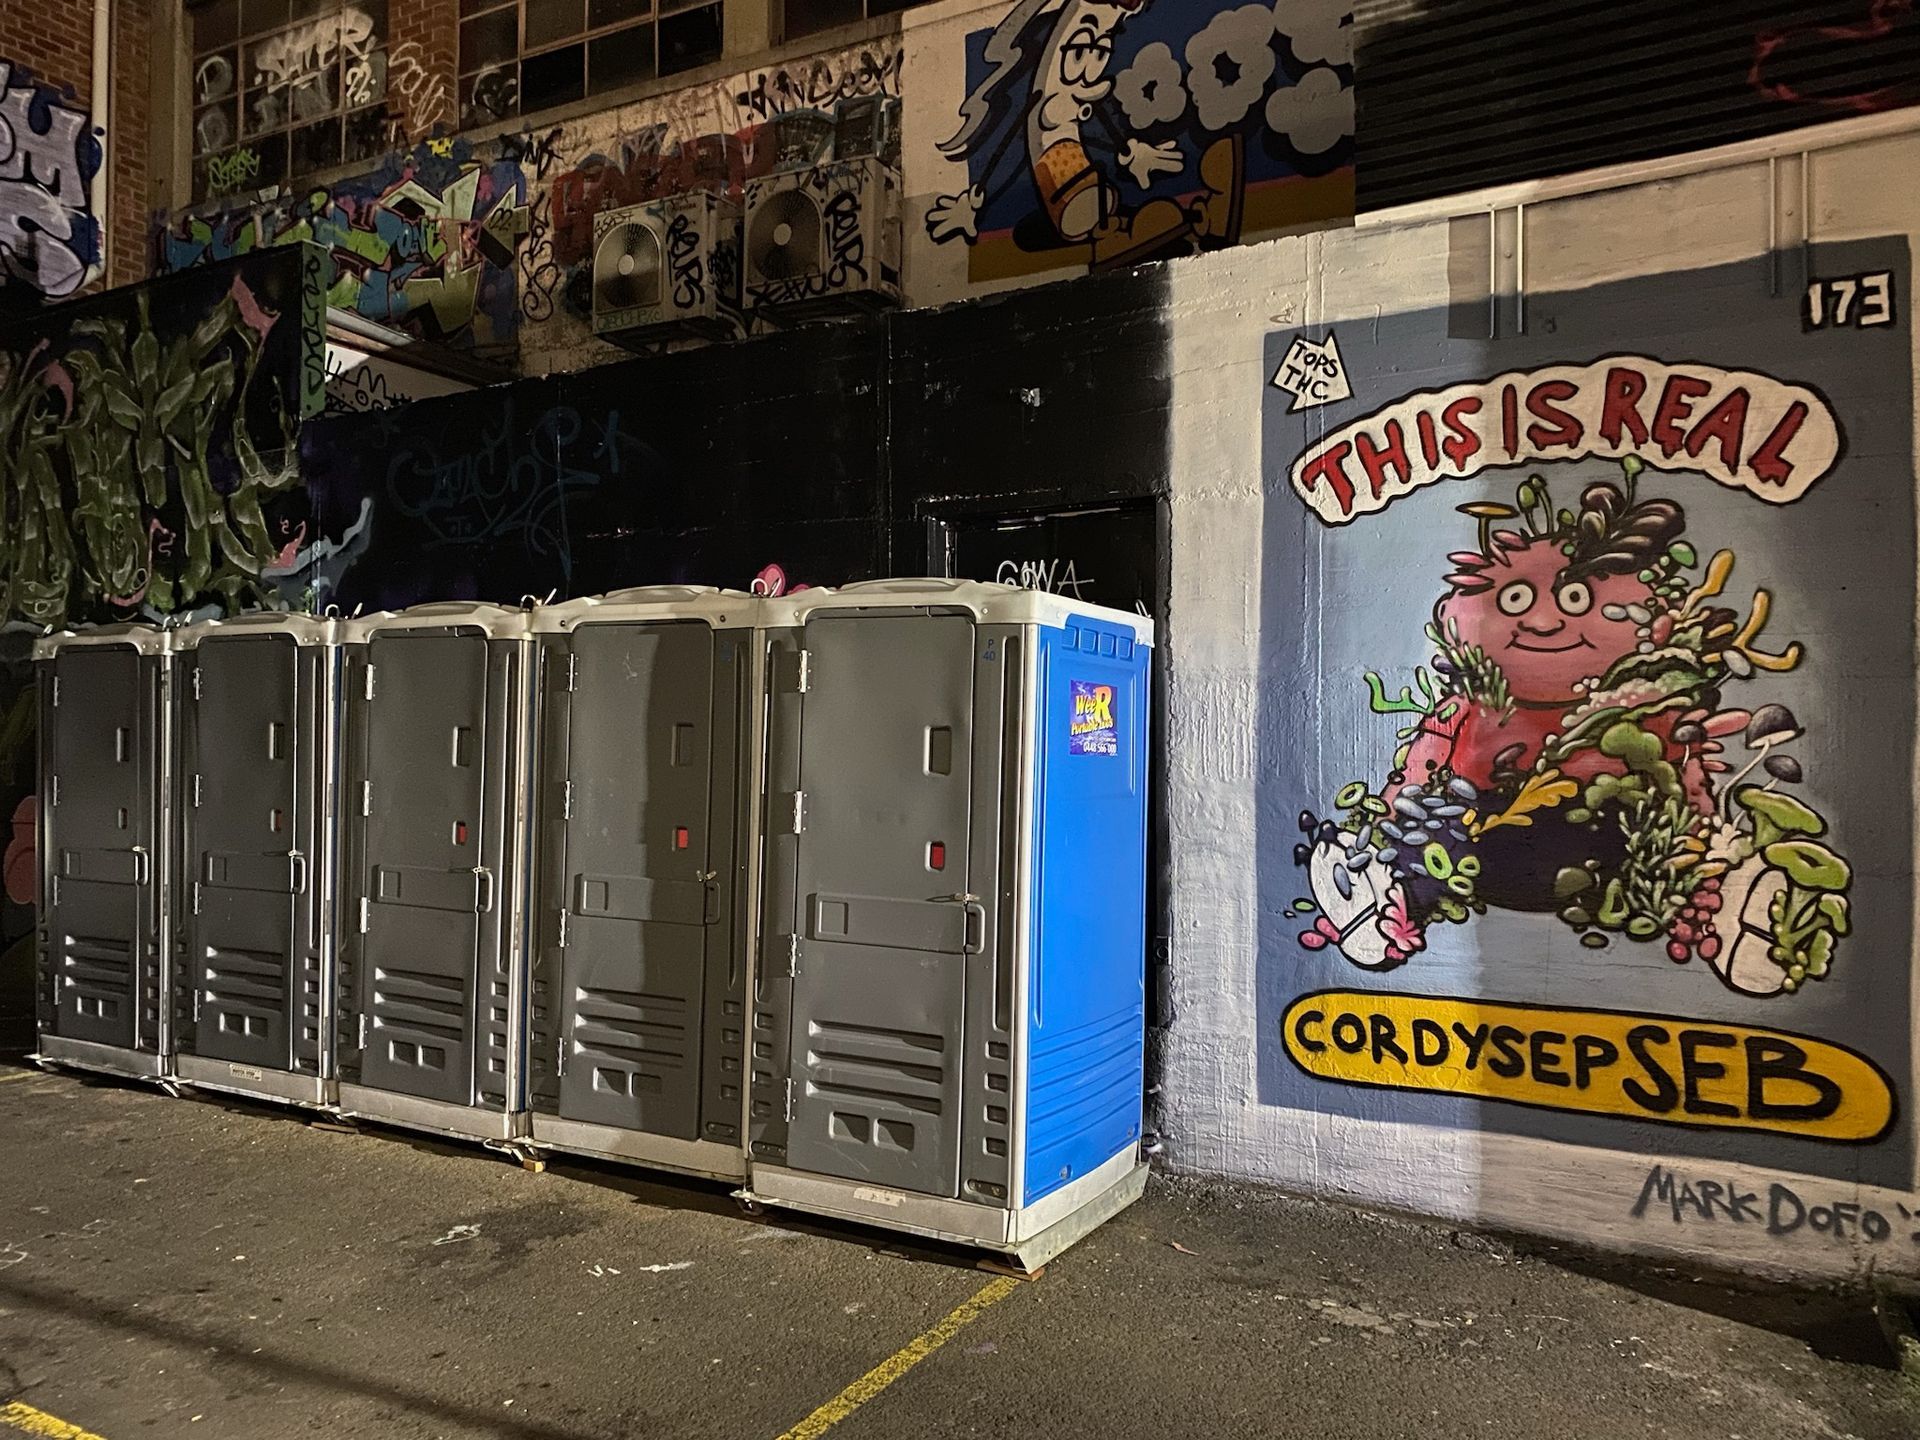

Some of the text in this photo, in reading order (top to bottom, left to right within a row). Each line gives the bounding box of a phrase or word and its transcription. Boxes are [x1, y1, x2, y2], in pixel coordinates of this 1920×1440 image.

[1807, 274, 1890, 326] 173
[1294, 338, 1340, 379] TOPS
[1284, 364, 1329, 403] THC
[1300, 367, 1808, 515] THIS IS REAL
[983, 651, 996, 661] 40
[988, 638, 994, 648] P
[1097, 743, 1107, 753] 566
[1630, 1165, 1762, 1224] MARK
[1765, 1182, 1892, 1242] DOFO
